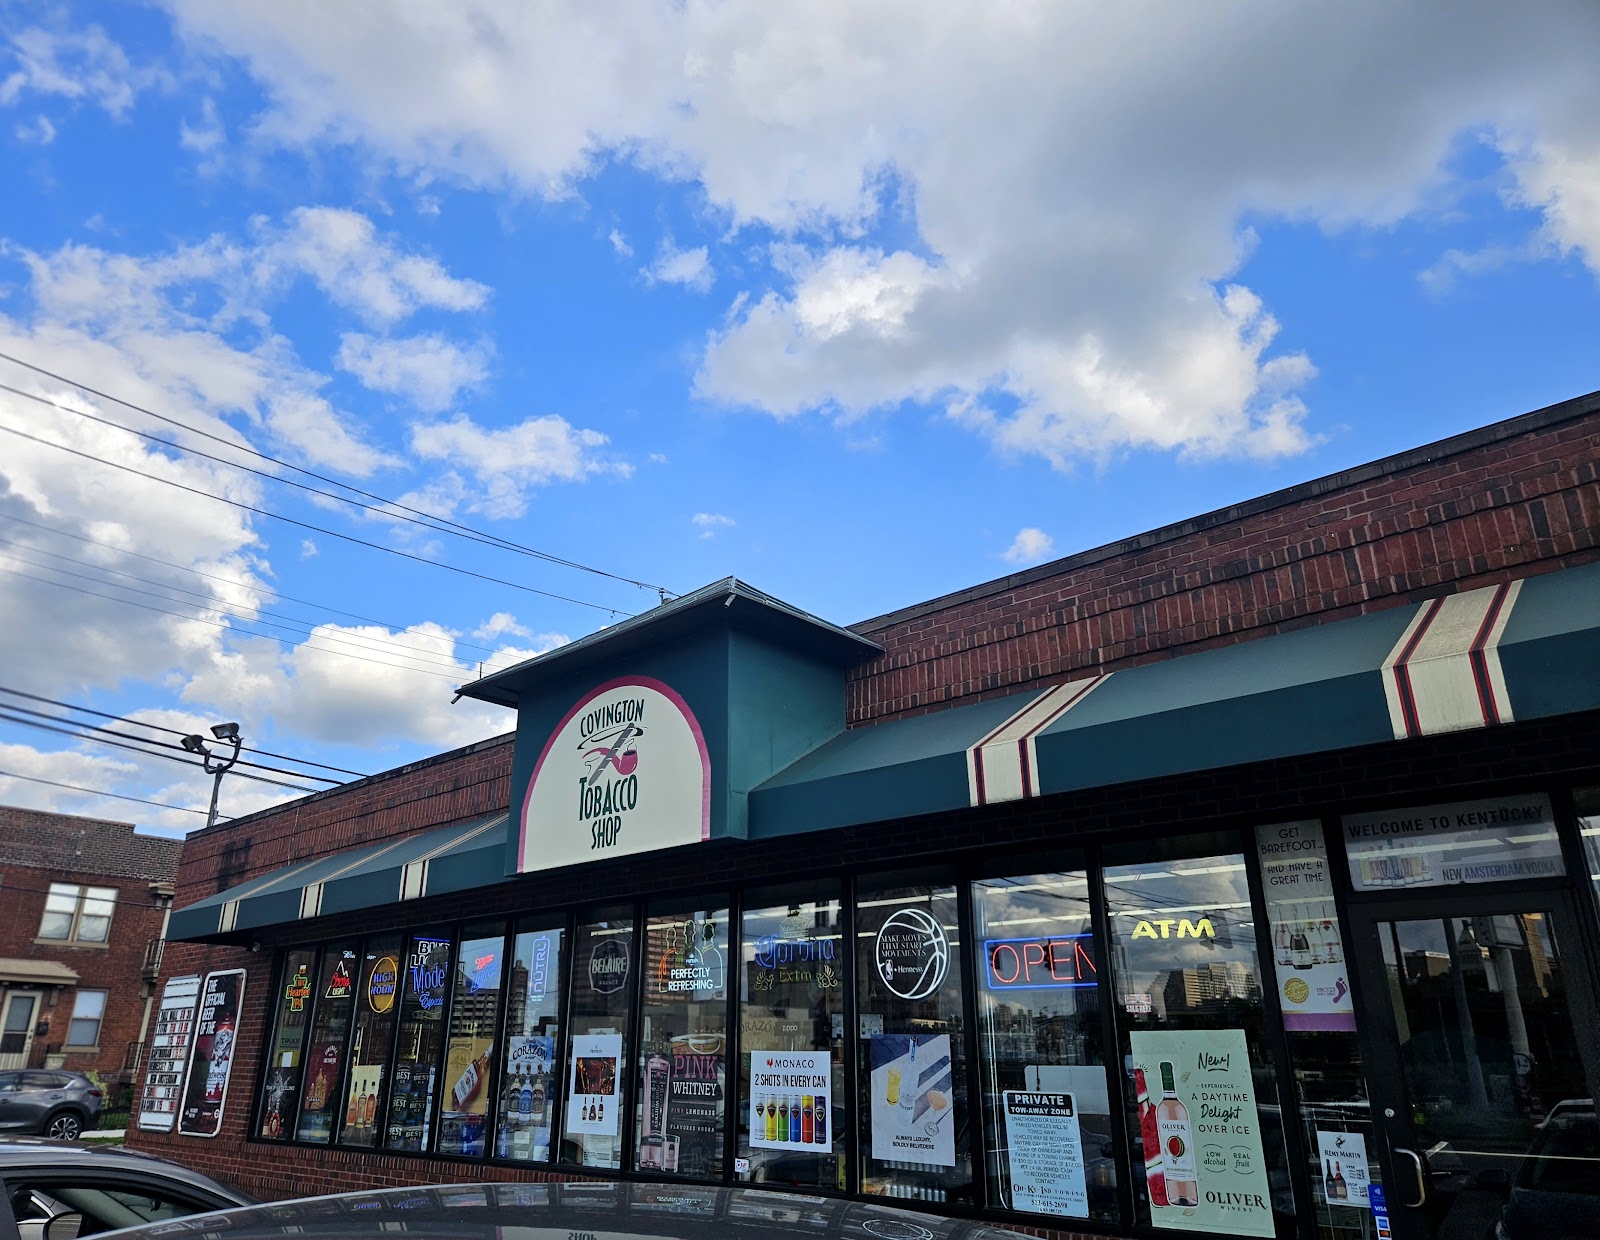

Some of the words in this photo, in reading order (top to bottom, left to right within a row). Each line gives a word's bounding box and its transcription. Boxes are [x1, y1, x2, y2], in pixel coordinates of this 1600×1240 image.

[580, 698, 645, 738] COVINGTON
[579, 773, 638, 821] TOBACCO
[1349, 818, 1424, 838] WELCOME
[1429, 816, 1450, 829] TO
[1456, 805, 1544, 827] KENTUCKY
[590, 815, 622, 850] SHOP
[1278, 827, 1299, 839] GET
[1267, 864, 1285, 874] AND
[1288, 861, 1312, 872] HAVE
[1316, 860, 1323, 869] A
[1441, 867, 1463, 881] NEW
[1464, 863, 1524, 880] AMSTERDAM
[1526, 860, 1557, 875] VODKA
[1270, 874, 1300, 886] GREAT
[1304, 872, 1324, 883] TIME
[1131, 918, 1216, 940] ATM
[881, 935, 900, 943] MAKE
[902, 933, 927, 942] MOVES
[881, 942, 898, 950] THAT
[900, 941, 924, 950] START
[881, 949, 927, 958] MOVEMENTS
[592, 956, 627, 975] BELAIRE
[897, 964, 925, 974] Hennessy
[991, 941, 1098, 984] OPEN
[373, 972, 394, 983] HIGH
[671, 967, 711, 979] PERFECTLY
[778, 966, 813, 983] Extra
[208, 979, 219, 993] THE
[370, 985, 395, 995] NOON
[668, 979, 714, 991] REFRESHING
[205, 992, 226, 1007] OFFICIAL
[202, 1007, 215, 1021] BEER
[200, 1022, 207, 1036] OF
[207, 1021, 216, 1035] THE
[741, 1020, 775, 1034] RAZÓ
[281, 1037, 300, 1045] TRULY
[672, 1054, 718, 1080] PINK
[774, 1058, 815, 1068] MONACO
[1198, 1052, 1230, 1070] New!
[396, 1071, 411, 1080] BEST
[754, 1073, 760, 1086] 2
[760, 1073, 781, 1086] SHOTS
[781, 1074, 789, 1087] IN
[790, 1074, 812, 1088] EVERY
[812, 1075, 827, 1088] CAN
[672, 1081, 717, 1097] WHITNEY
[1014, 1094, 1065, 1106] PRIVATE
[1191, 1093, 1198, 1101] A
[1202, 1093, 1249, 1102] DAYTIME
[1010, 1106, 1049, 1115] TOW-AWAY
[1050, 1108, 1071, 1116] ZONE
[1200, 1103, 1243, 1123] Delight
[1161, 1123, 1186, 1131] OLIVER
[1198, 1124, 1228, 1134] OVER
[1232, 1125, 1250, 1135] ICE
[1203, 1157, 1226, 1166] alcohol
[1233, 1152, 1251, 1160] REAL
[1234, 1159, 1250, 1168] fruit
[1205, 1190, 1268, 1210] OLIVER
